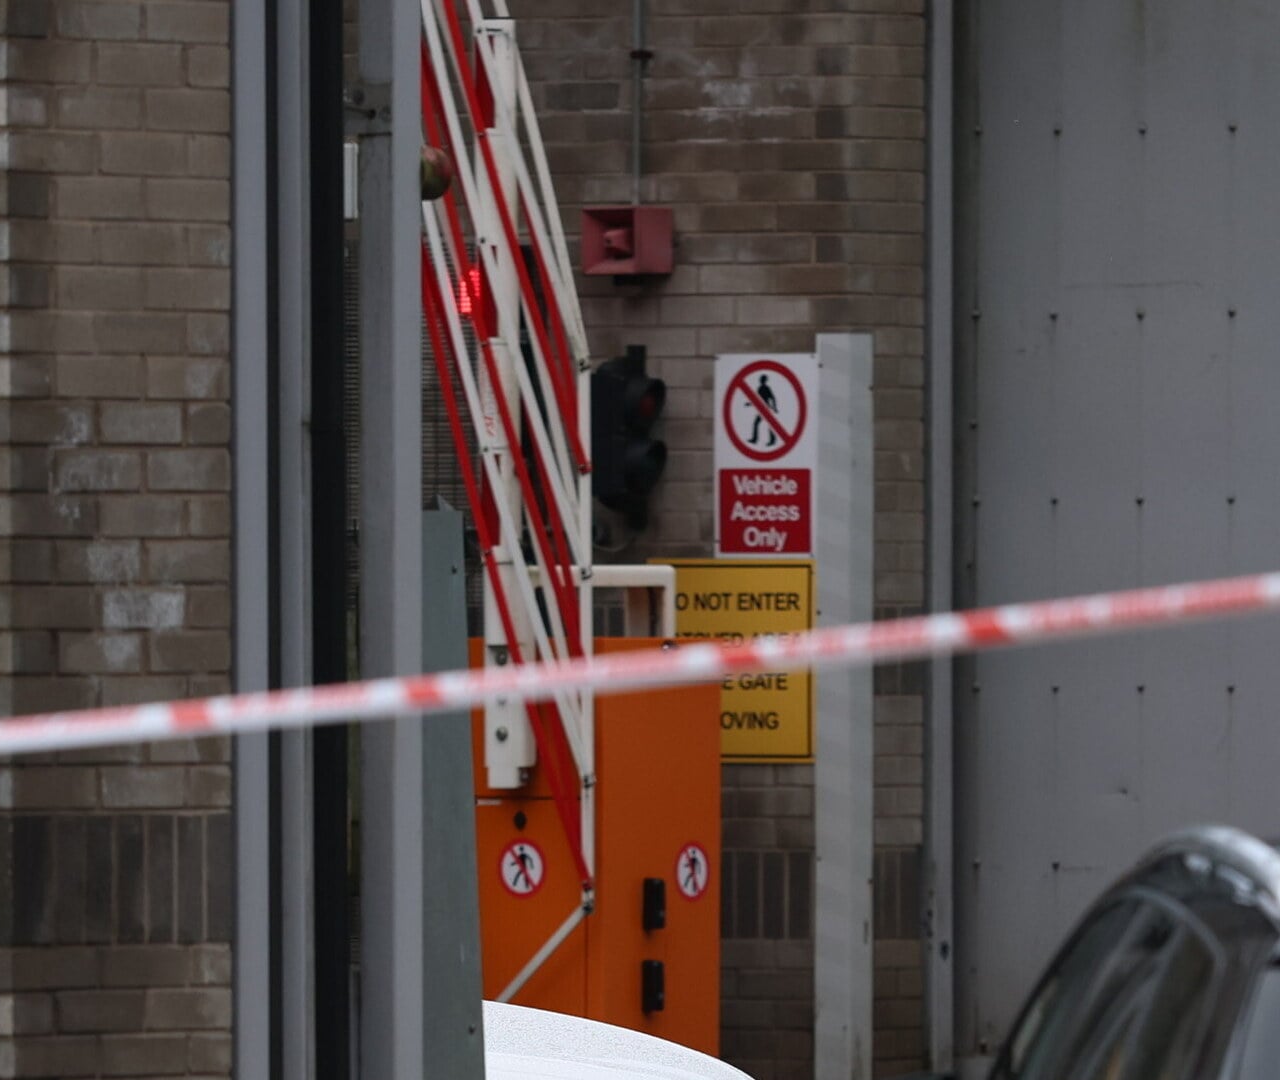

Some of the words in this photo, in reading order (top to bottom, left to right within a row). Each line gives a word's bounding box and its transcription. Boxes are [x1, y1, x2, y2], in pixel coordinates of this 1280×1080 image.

[732, 475, 798, 495] Vehicle
[730, 500, 800, 521] Access
[743, 526, 787, 551] Only
[694, 592, 732, 611] NOT
[737, 592, 801, 611] ENTER
[739, 672, 789, 691] GATE
[720, 711, 780, 730] OVING
